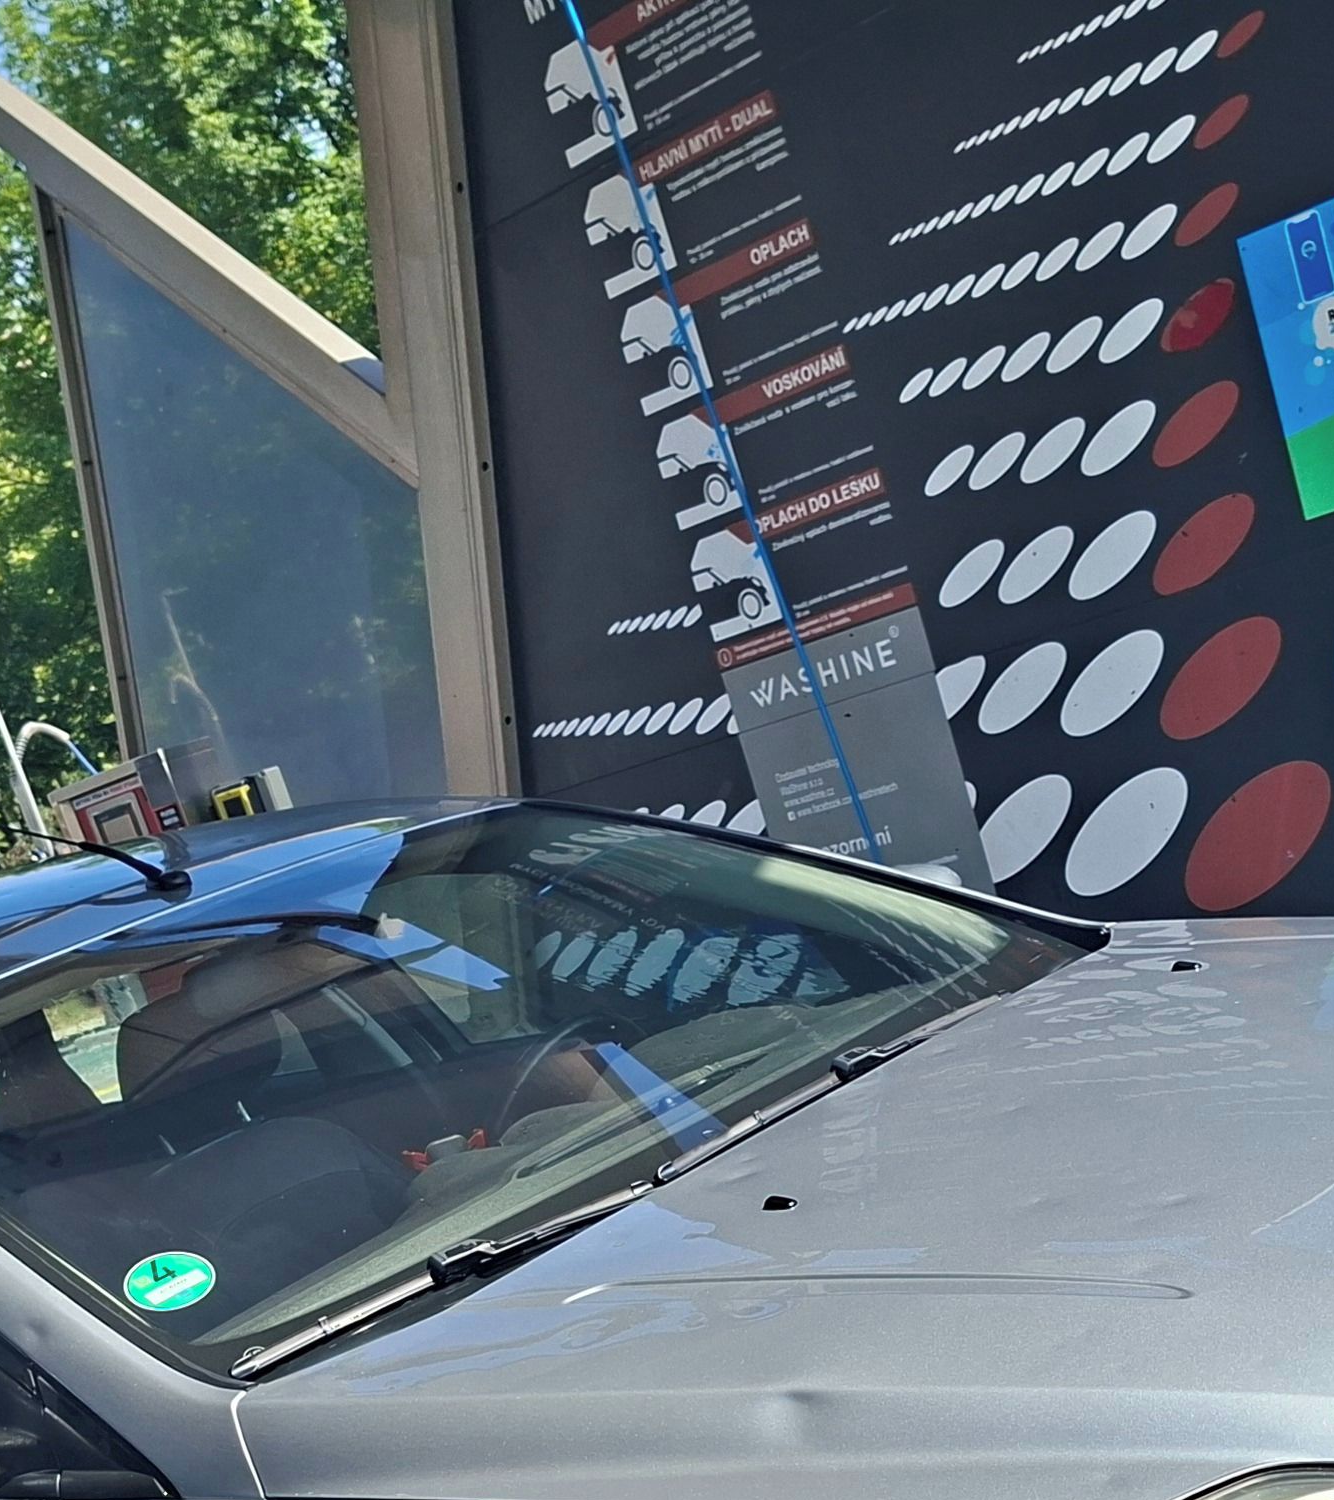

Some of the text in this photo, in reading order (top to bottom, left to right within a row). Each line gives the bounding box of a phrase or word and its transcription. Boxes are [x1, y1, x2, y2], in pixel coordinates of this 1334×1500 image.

[750, 223, 811, 266] OPLACH
[761, 344, 847, 399] VOSKOVÁNÍ
[808, 492, 832, 514] DO
[831, 471, 882, 505] LESKU
[150, 1260, 177, 1282] 4
